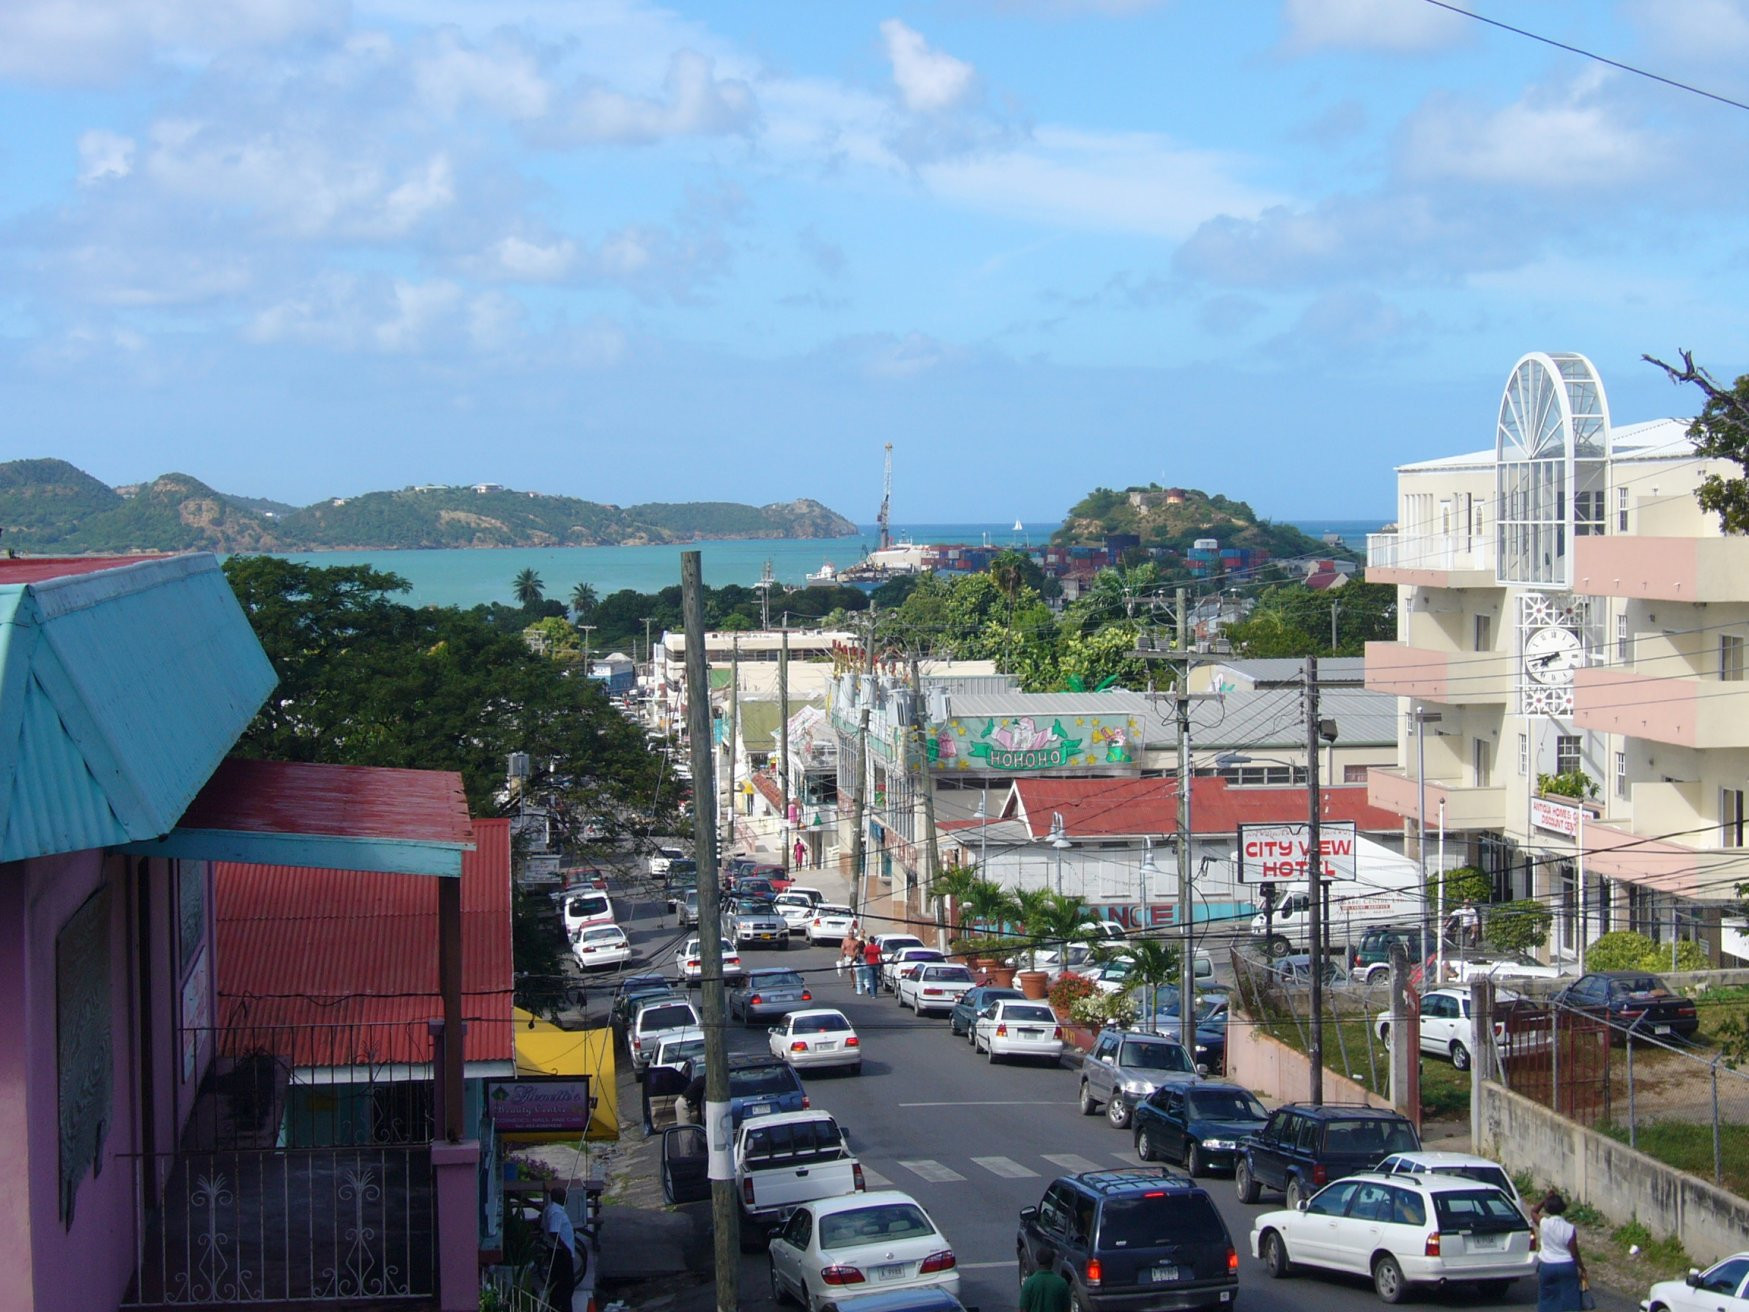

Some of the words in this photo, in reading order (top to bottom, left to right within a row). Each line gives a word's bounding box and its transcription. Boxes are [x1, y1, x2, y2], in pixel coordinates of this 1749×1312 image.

[1541, 814, 1564, 829] DISCOUNT
[1245, 841, 1293, 858] CITY
[1298, 839, 1352, 856] VEW
[1263, 861, 1336, 877] HOTL
